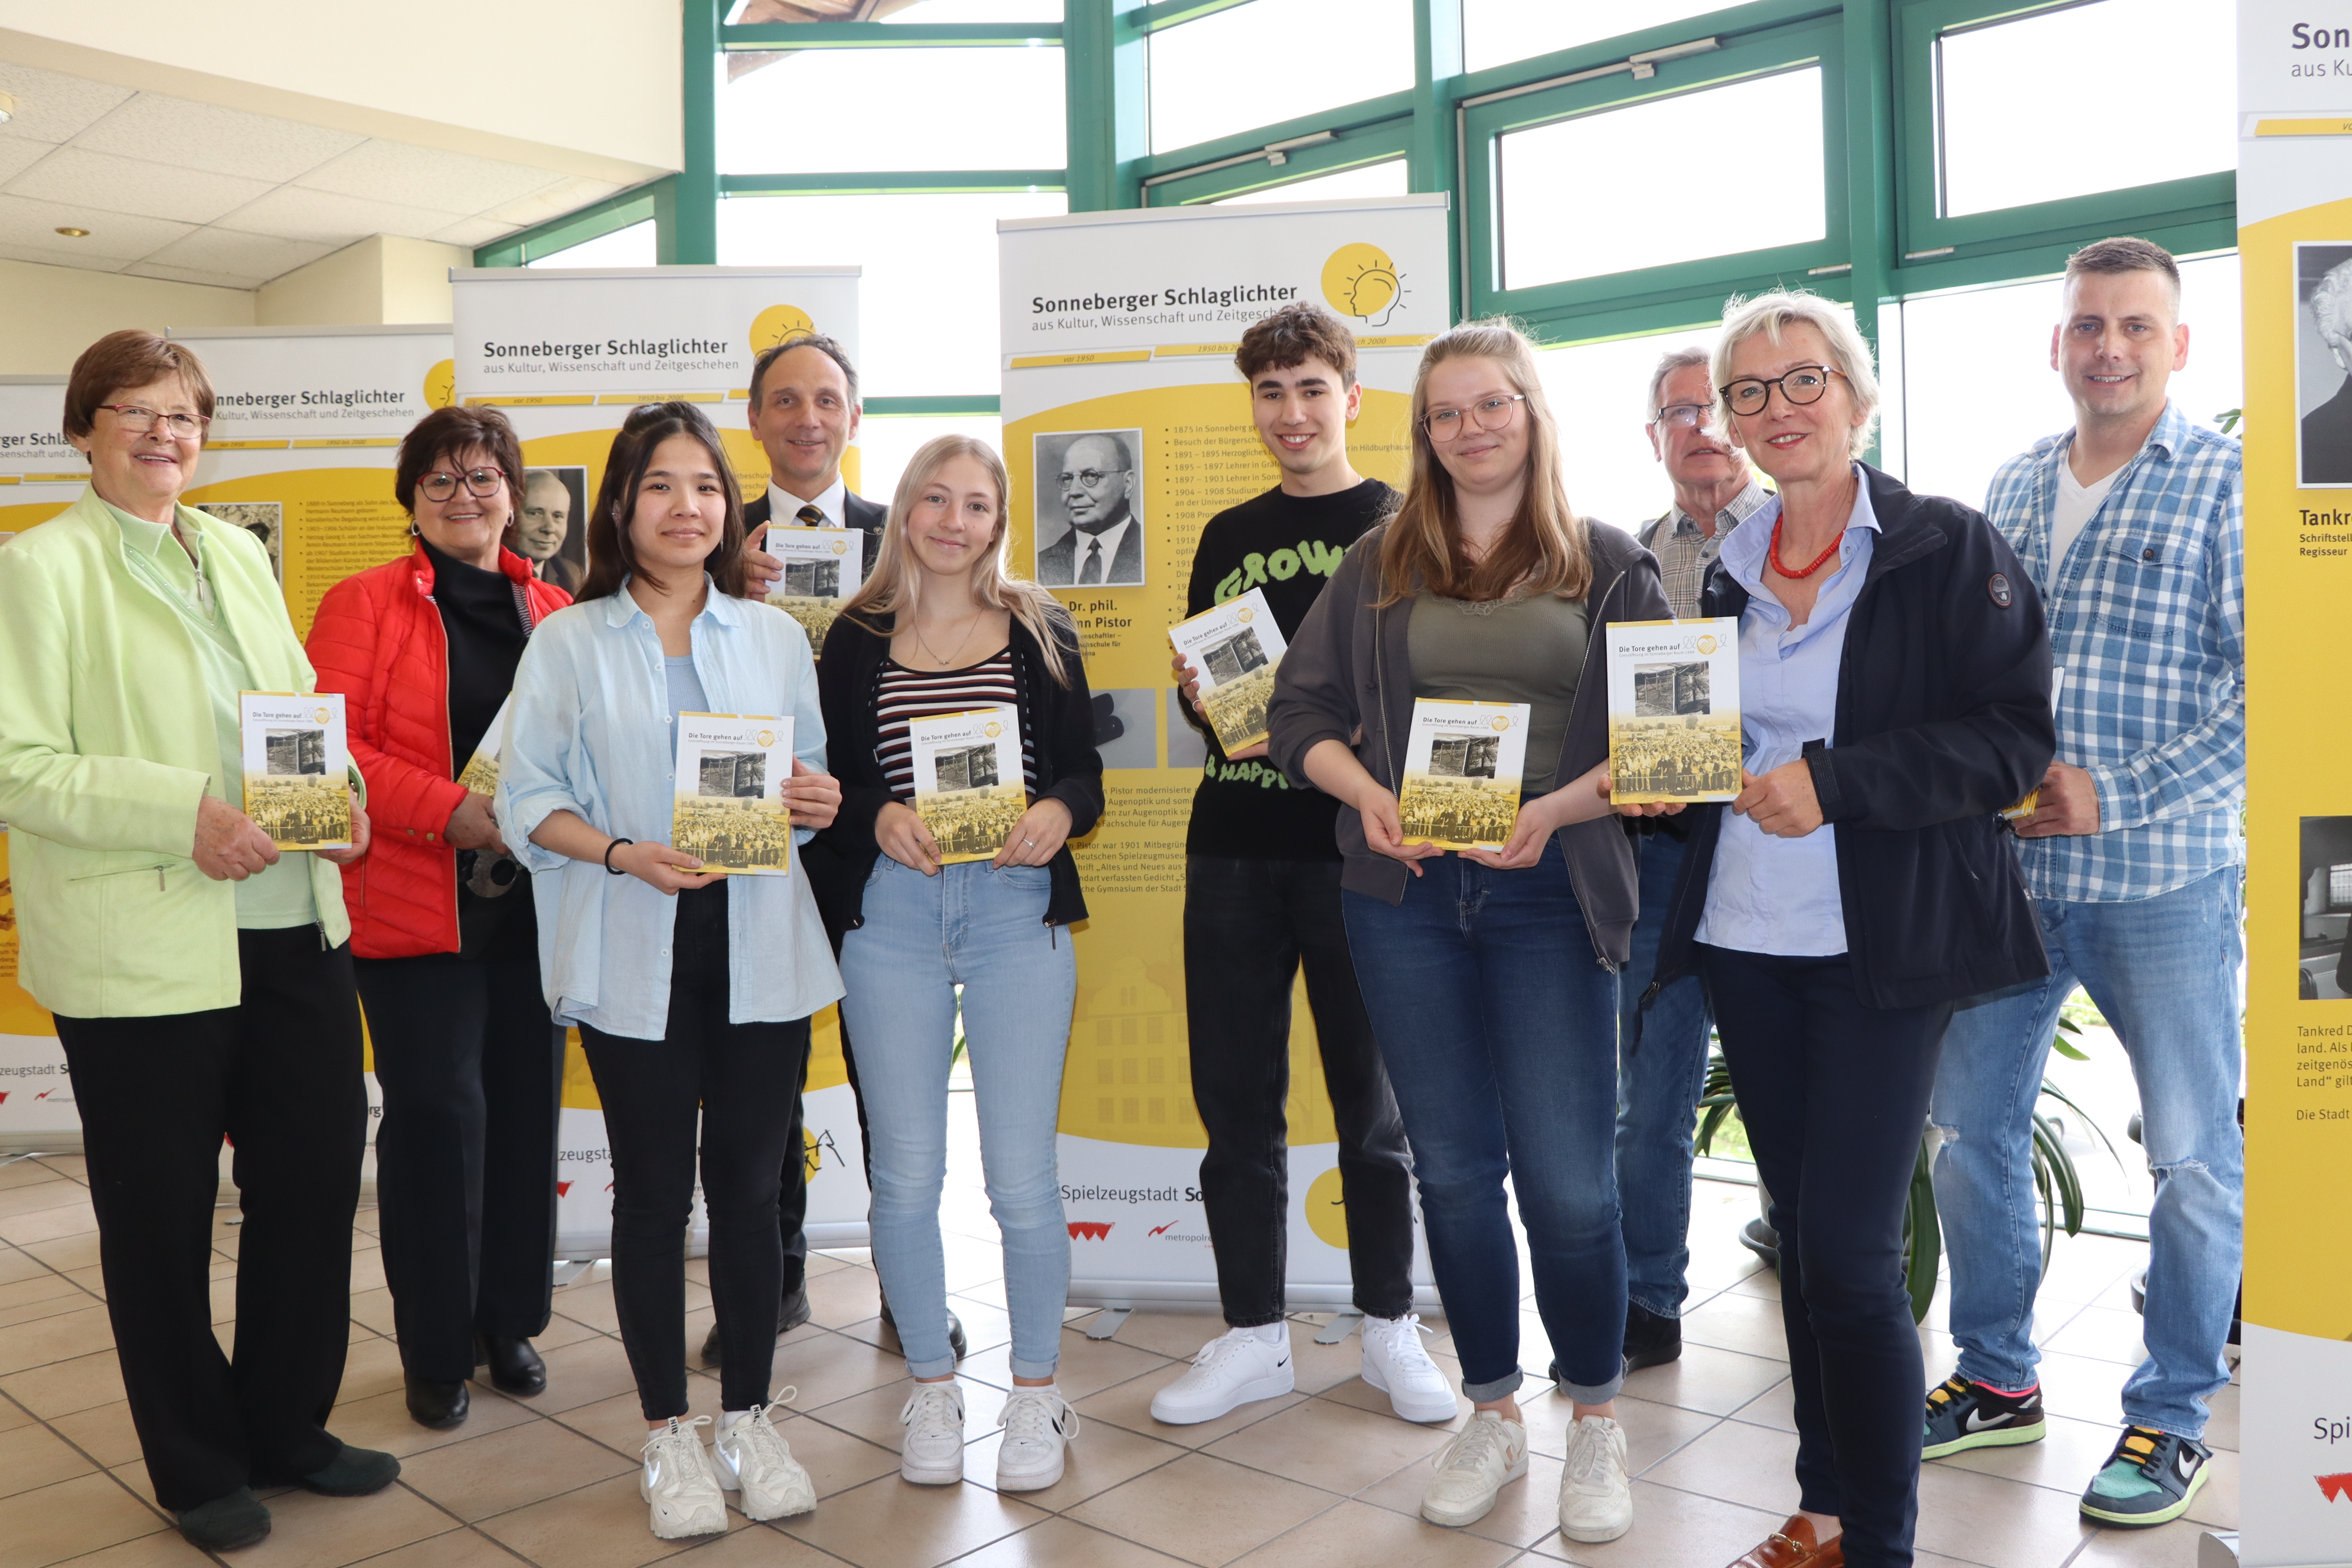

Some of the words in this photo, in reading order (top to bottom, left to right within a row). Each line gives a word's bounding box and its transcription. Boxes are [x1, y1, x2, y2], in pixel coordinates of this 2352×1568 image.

[2291, 63, 2327, 77] aus
[1032, 292, 1158, 314] Sonneberger
[1164, 285, 1298, 307] Schlaglichter
[1032, 321, 1054, 331] aus
[1058, 317, 1098, 329] Kultur,
[1101, 311, 1185, 326] Wissenschaft
[1189, 311, 1213, 322] und
[1217, 307, 1278, 322] Zeitgesch
[484, 341, 601, 360] Sonneberger
[607, 338, 728, 360] Schlaglichter
[484, 364, 505, 374] aus
[508, 362, 546, 374] Kultur,
[549, 360, 626, 373] Wissenschaft
[629, 360, 651, 371] und
[655, 359, 739, 372] Zeitgeschehen
[301, 389, 405, 407] Schlaglichter
[251, 409, 317, 420] Wissenschaft
[319, 409, 338, 419] und
[341, 407, 414, 419] Zeitgeschehen
[1205, 424, 1246, 433] Sonneberg
[30, 433, 75, 447] Schla
[1219, 436, 1264, 446] Bürgerschu
[48, 449, 66, 458] und
[1221, 448, 1267, 458] Herzogliches
[1201, 496, 1243, 505] Universität
[2299, 508, 2352, 526] Tankr
[2299, 533, 2352, 543] Schriftstell
[2299, 547, 2348, 558] Regisseur
[1069, 601, 1086, 612] Dr.
[1090, 599, 1118, 614] phil.
[1096, 617, 1132, 628] Pistor
[1204, 627, 1219, 638] gehen
[1647, 644, 1668, 652] gehen
[1136, 786, 1191, 794] modernisierte
[1108, 797, 1154, 806] Augenoptik
[1133, 808, 1178, 818] Augenoptik
[1148, 818, 1159, 827] für
[1119, 852, 1187, 861] Spielzeugmuseu
[1097, 884, 1143, 894] Gymnasium
[1161, 884, 1181, 892] Stadt
[2297, 1025, 2343, 1037] Tankred
[2297, 1042, 2327, 1053] land.
[2330, 1042, 2347, 1053] Als
[2297, 1109, 2315, 1120] Die
[2318, 1108, 2350, 1120] Stadt
[1061, 1184, 1178, 1204] Spielzeugstadt
